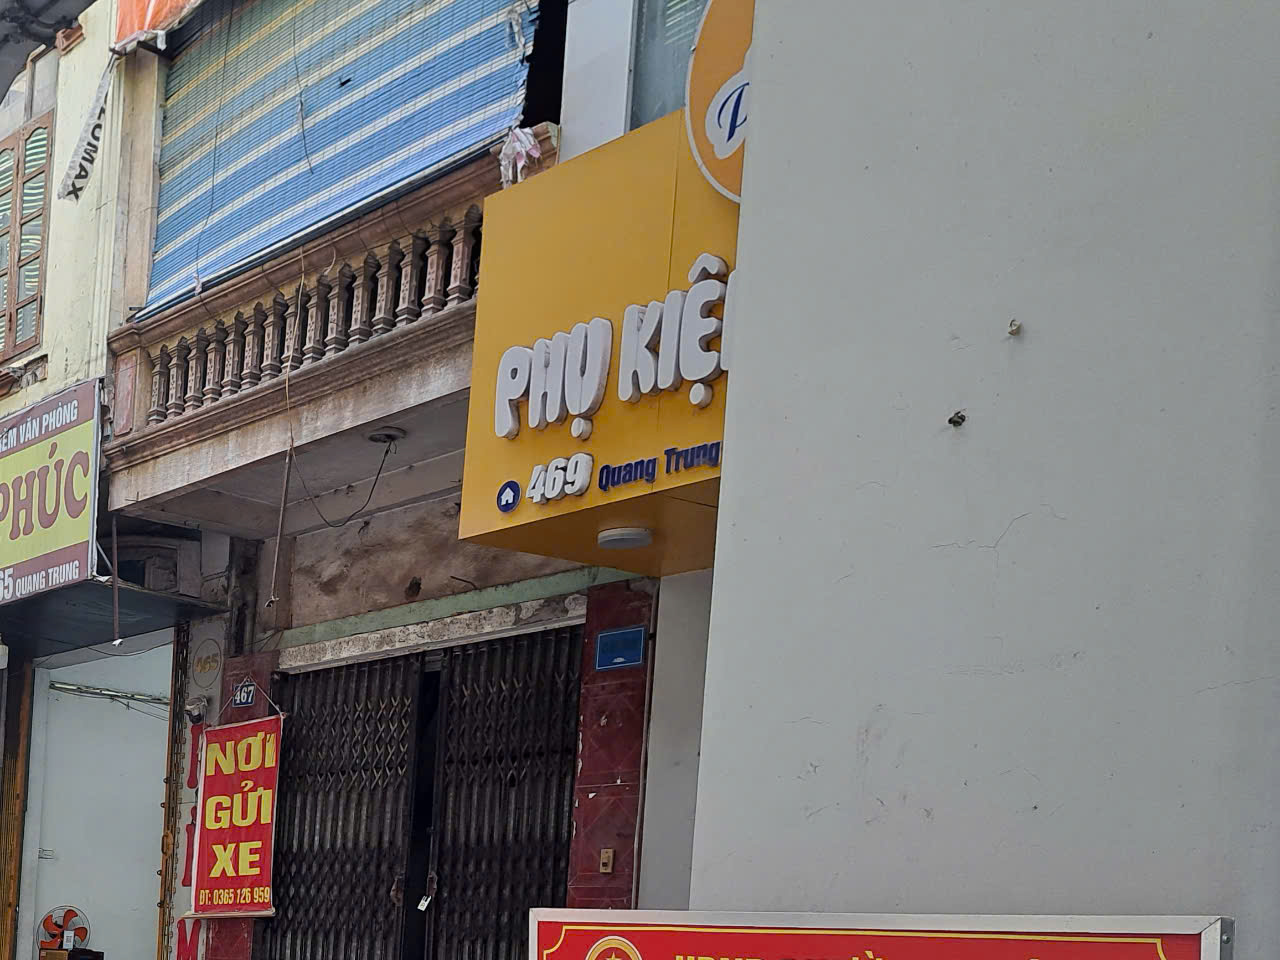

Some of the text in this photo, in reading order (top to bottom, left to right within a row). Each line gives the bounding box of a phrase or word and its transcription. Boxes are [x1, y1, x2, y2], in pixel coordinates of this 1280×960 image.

[495, 253, 737, 441] PHỤ KIỆ
[19, 415, 40, 443] VĂN
[41, 400, 78, 434] PHÒNG
[525, 441, 721, 505] 469 Quang Trung
[15, 572, 46, 597] QUANG
[47, 560, 80, 587] TRUNG
[233, 685, 254, 704] 467
[206, 731, 277, 776] NƠI
[205, 780, 272, 830] GỬI
[209, 840, 262, 878] XE
[213, 888, 234, 905] 0365
[236, 887, 251, 904] 126
[253, 886, 270, 904] 959
